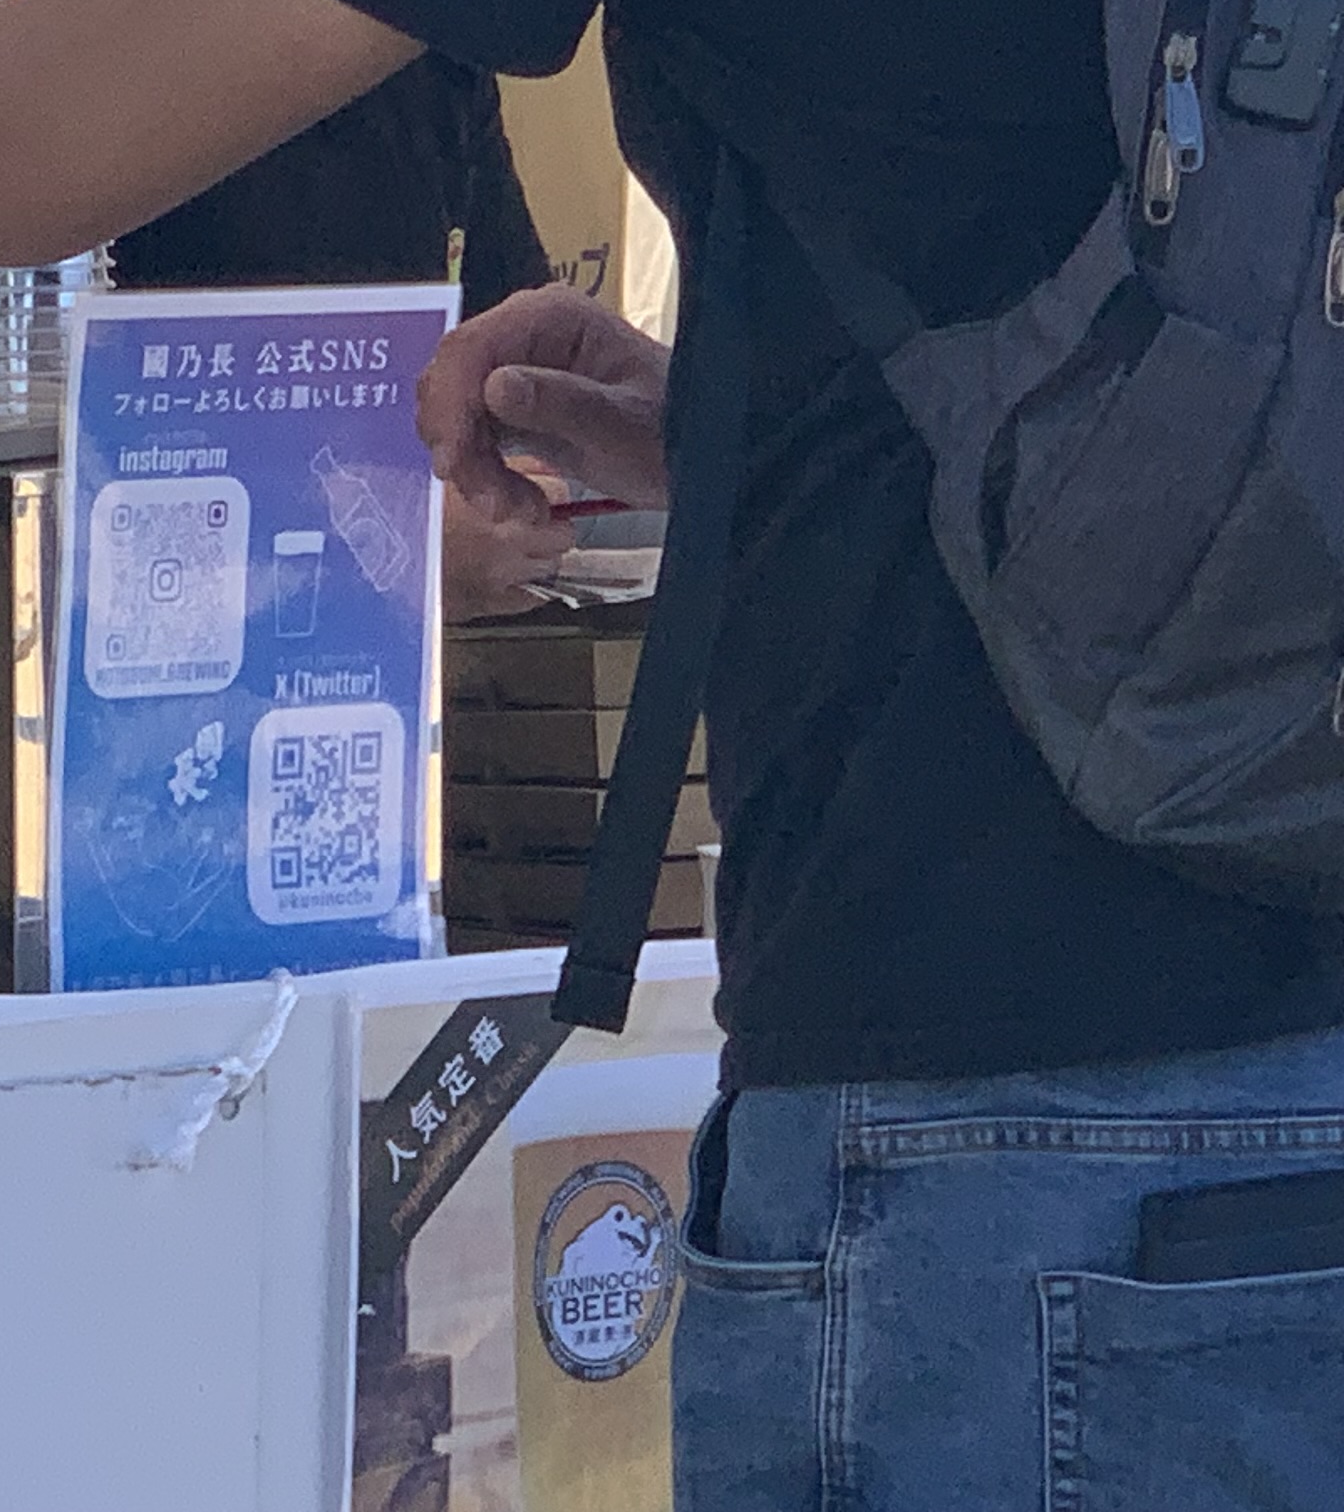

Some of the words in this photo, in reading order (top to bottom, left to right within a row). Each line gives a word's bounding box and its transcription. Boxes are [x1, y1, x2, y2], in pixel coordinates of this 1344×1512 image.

[386, 1015, 507, 1184] 人気定番
[561, 1289, 645, 1325] BEER
